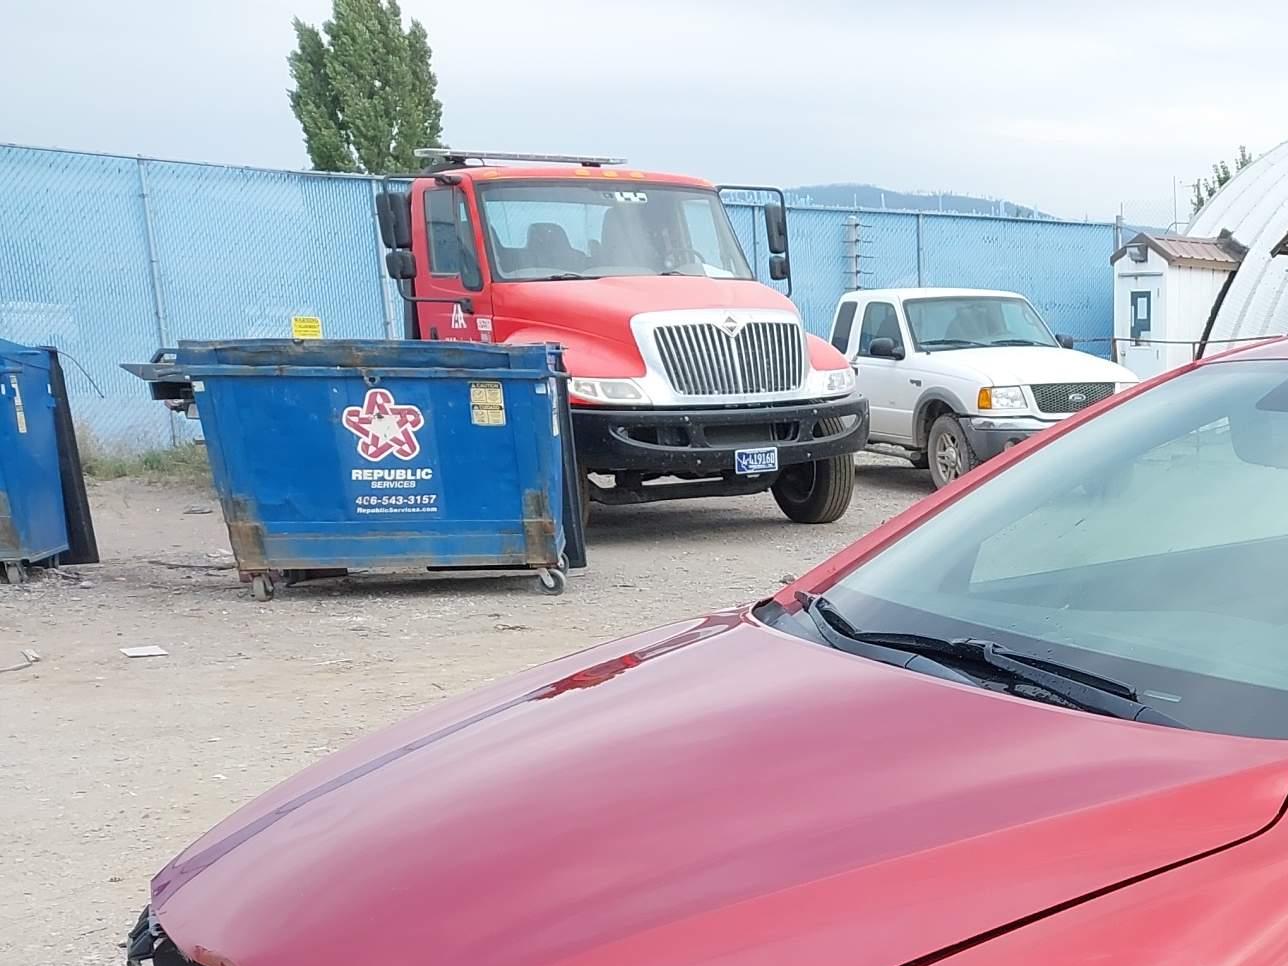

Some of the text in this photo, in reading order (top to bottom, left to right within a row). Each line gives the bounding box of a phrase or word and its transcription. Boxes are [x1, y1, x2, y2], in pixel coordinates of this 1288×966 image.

[351, 468, 433, 480] REPUBLIC
[371, 481, 416, 489] SERVICES
[355, 495, 437, 505] 406-543-3157
[357, 506, 437, 514] RepublicServices.com
